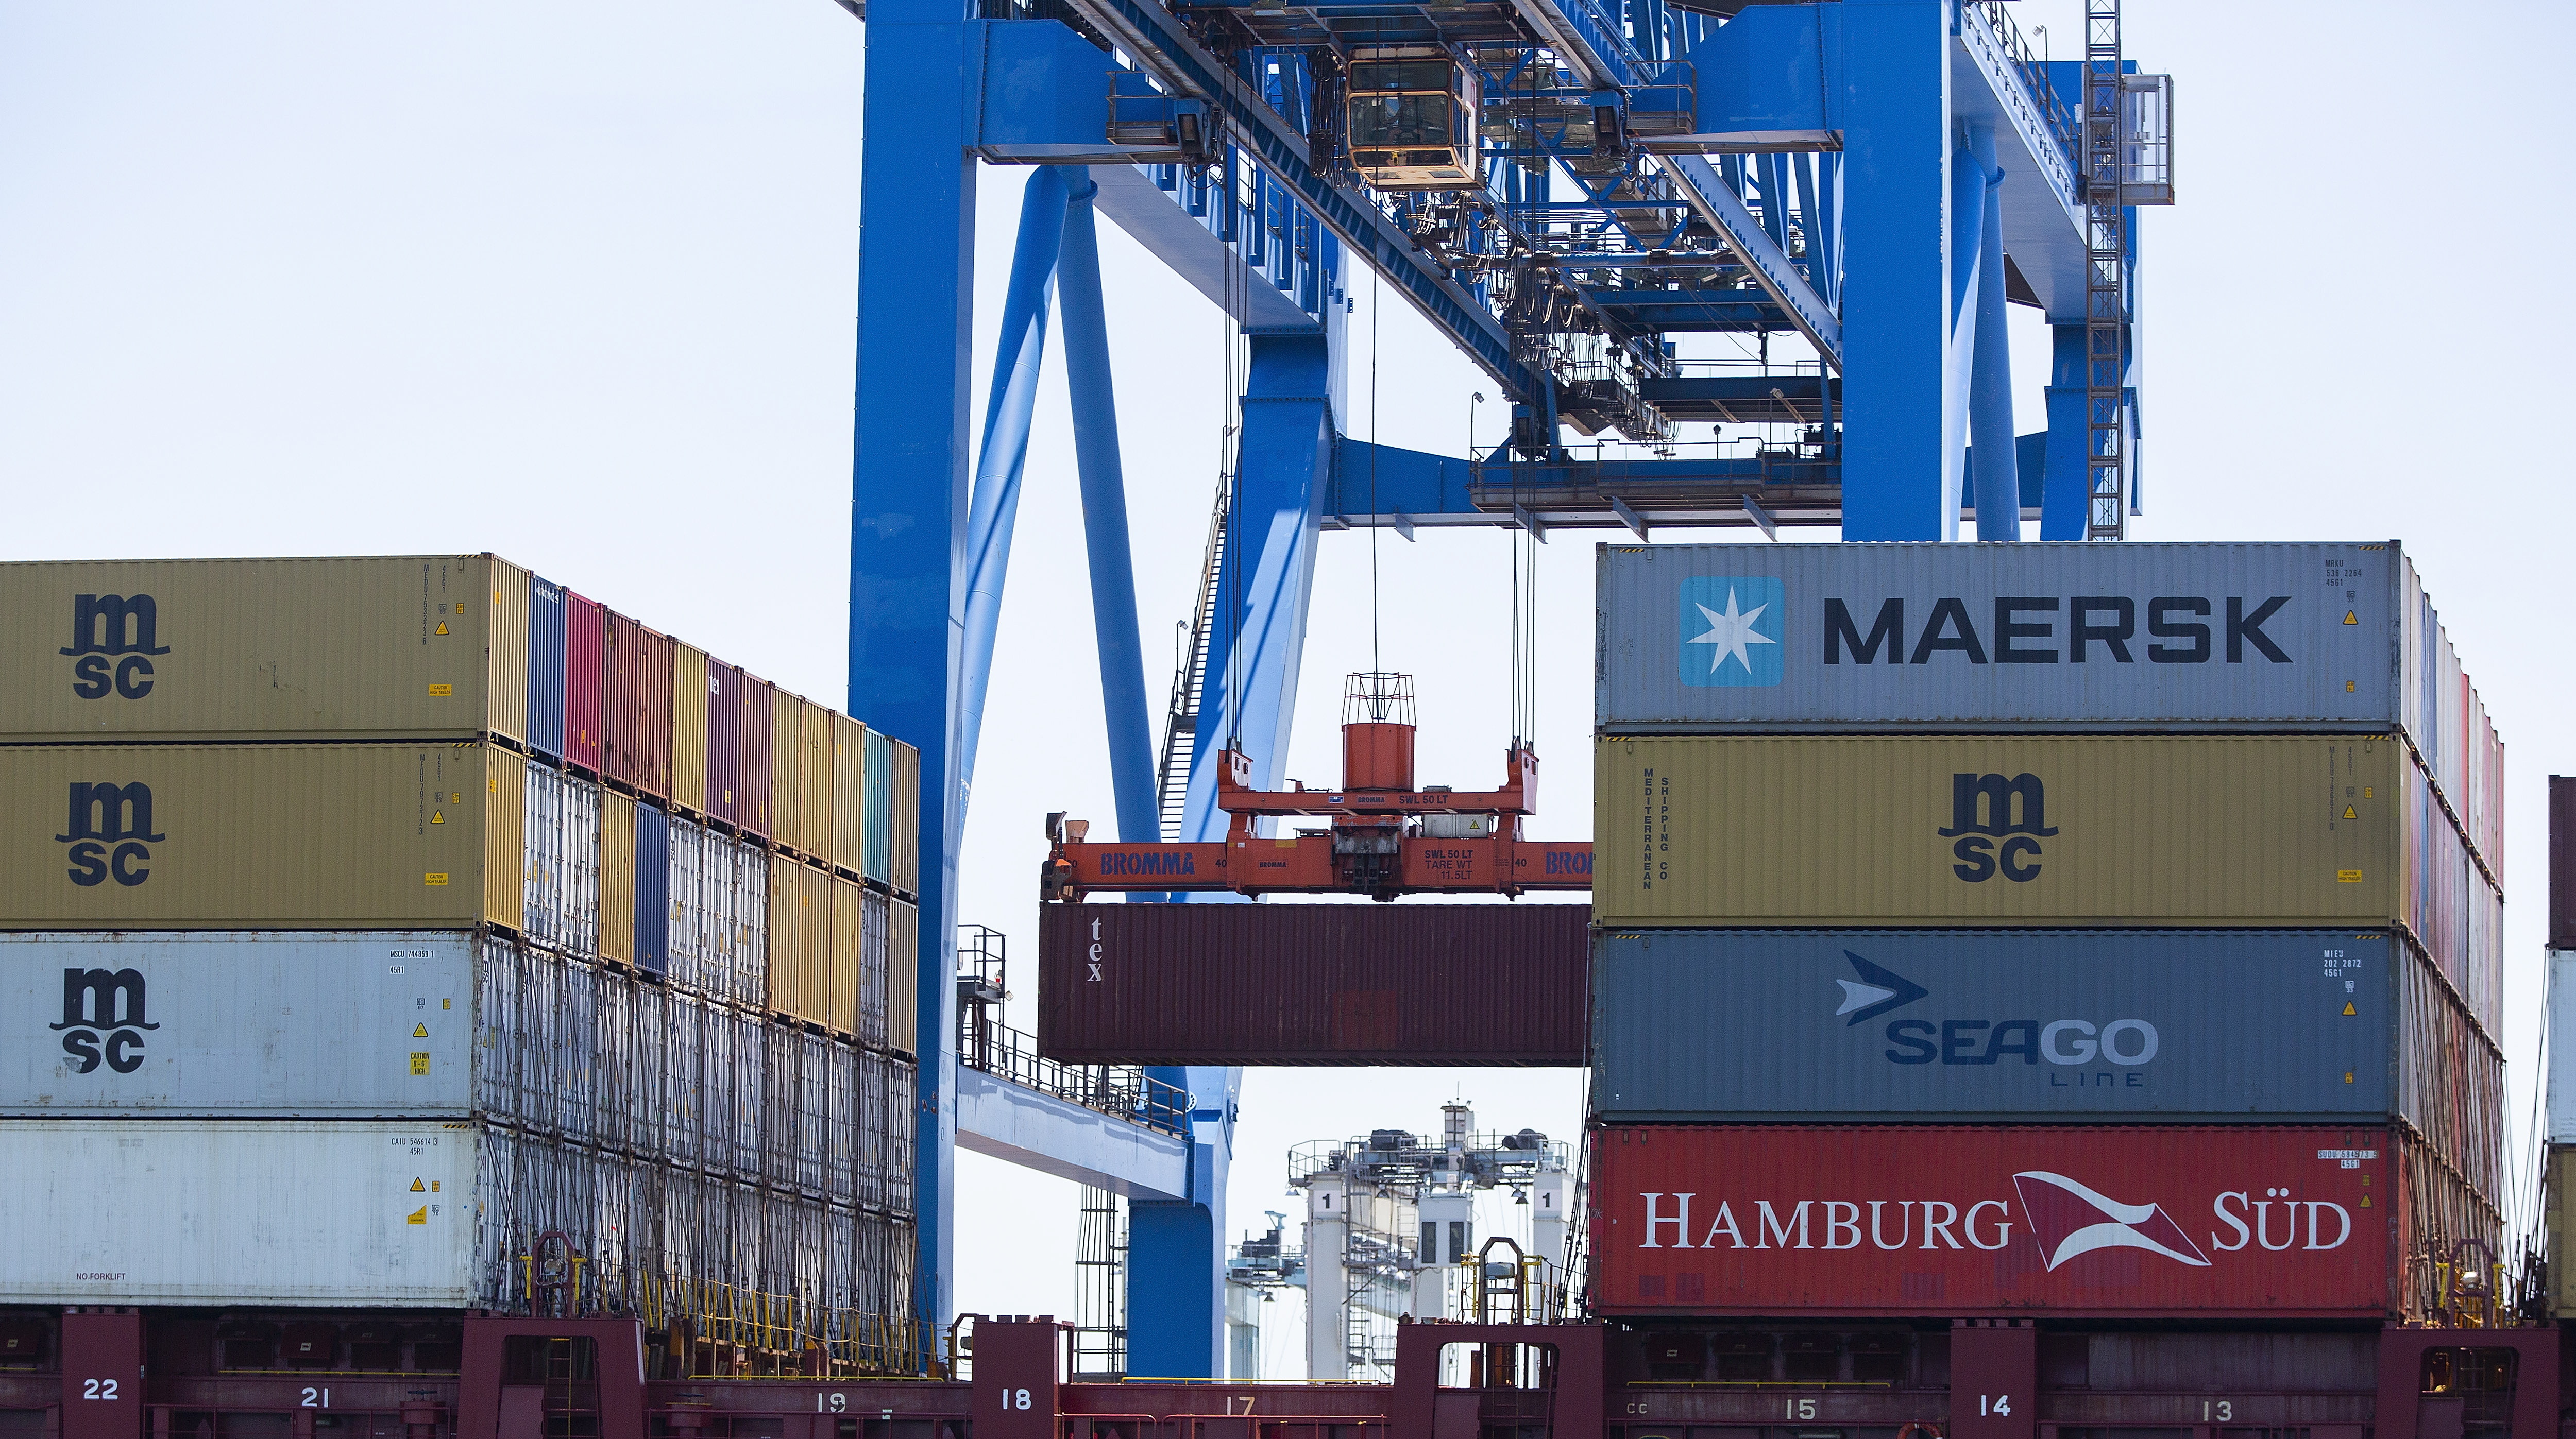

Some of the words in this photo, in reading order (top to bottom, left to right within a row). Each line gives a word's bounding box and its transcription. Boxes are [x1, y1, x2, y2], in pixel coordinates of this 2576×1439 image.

[1824, 596, 2294, 665] MAERSK
[1399, 795, 1419, 804] SWL
[1422, 795, 1434, 804] 50
[1437, 795, 1448, 804] LT
[1660, 777, 1669, 851] SHIPPING
[1643, 768, 1653, 889] MEDITERRANEAN
[1100, 852, 1195, 875] BROMMA
[1215, 859, 1227, 868] 40
[1425, 850, 1445, 859] SWL
[1448, 850, 1460, 859] 50
[1462, 850, 1473, 859] LT
[1426, 860, 1453, 869] TARE
[1456, 860, 1473, 869] WT
[1515, 859, 1527, 867] 40
[1087, 917, 1103, 981] tex
[2324, 950, 2343, 958] MIEU
[2324, 969, 2342, 977] 45G1
[1885, 1019, 2159, 1065] SEAGO
[1322, 1193, 1330, 1209] 1
[1543, 1192, 1551, 1208] 1
[1639, 1192, 2013, 1250] HAMBURG
[2211, 1188, 2351, 1251] SÜD
[83, 1379, 119, 1400] 22
[301, 1387, 329, 1408] 21
[1002, 1389, 1031, 1410] 18
[818, 1392, 845, 1413] 19
[1227, 1396, 1255, 1416] 17
[1786, 1399, 1817, 1420] 15
[1981, 1395, 2011, 1417] 14
[2204, 1401, 2232, 1422] 13
